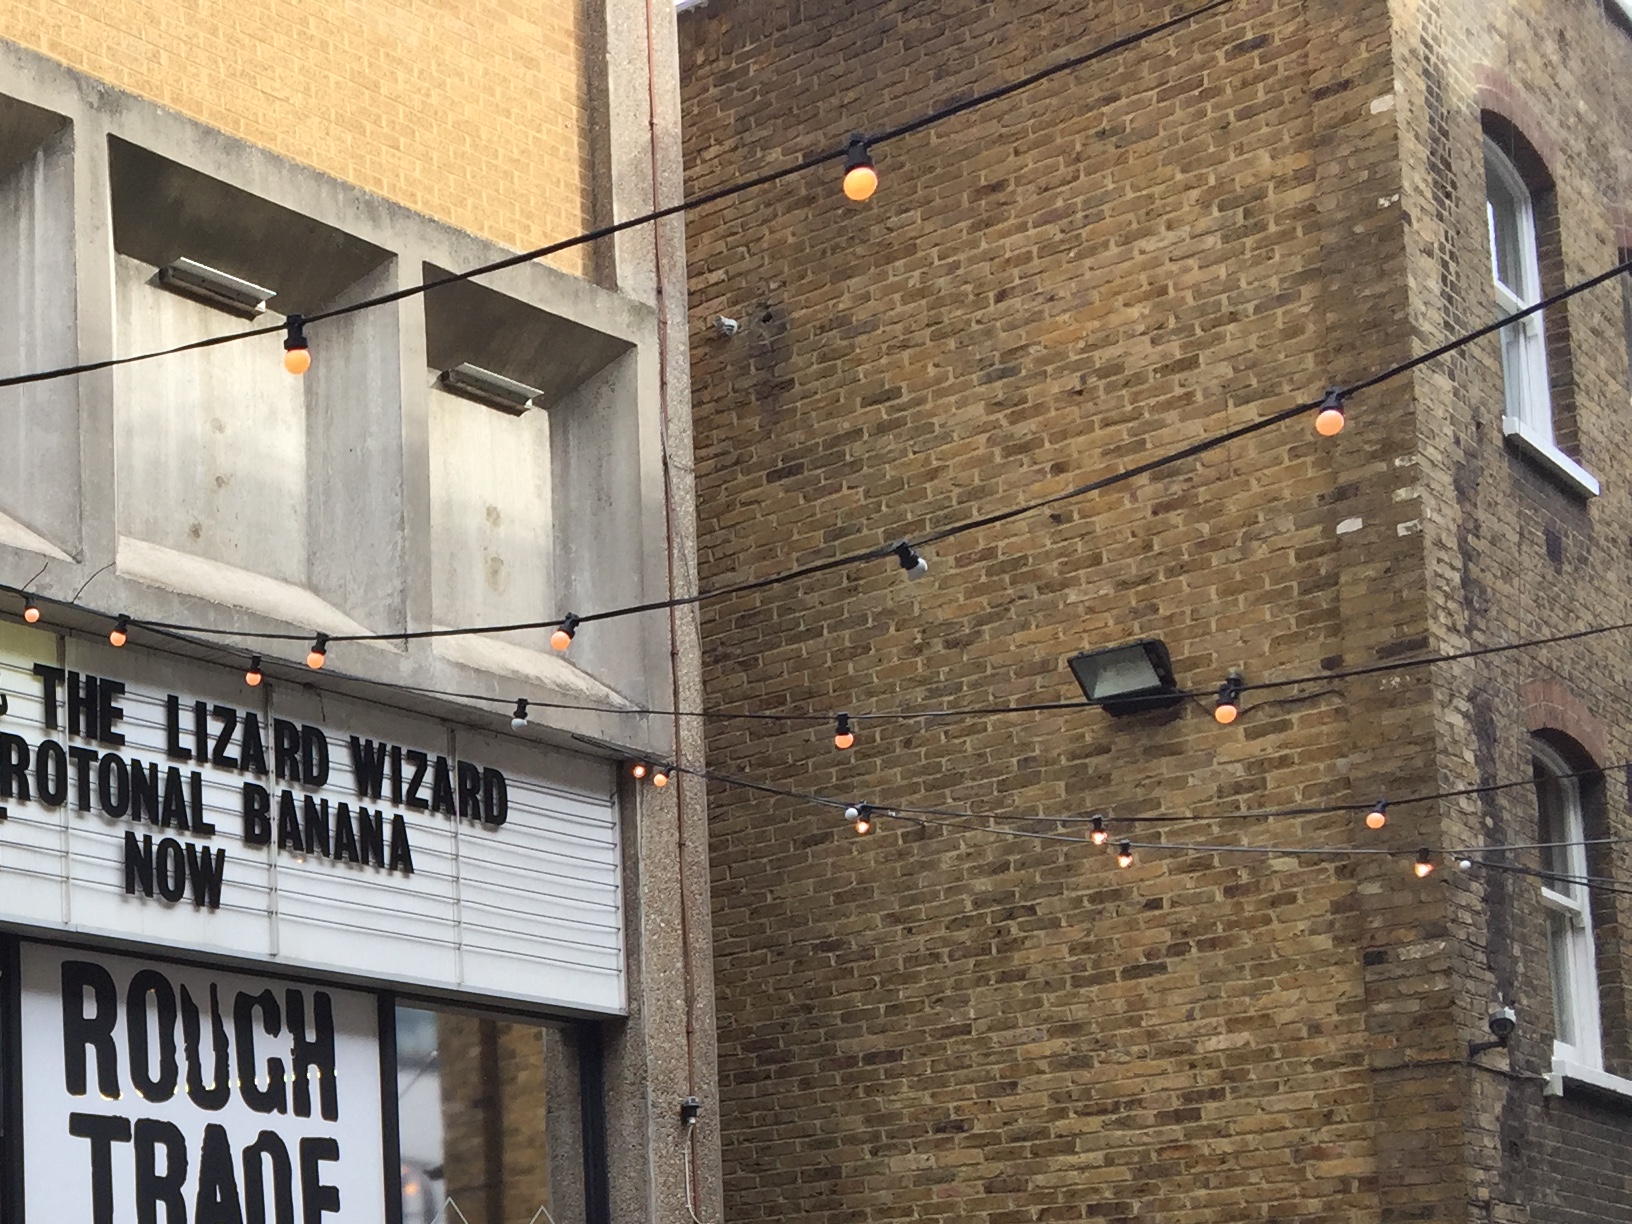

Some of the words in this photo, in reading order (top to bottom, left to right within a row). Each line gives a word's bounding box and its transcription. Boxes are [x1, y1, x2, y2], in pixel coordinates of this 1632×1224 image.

[33, 662, 126, 746] THE
[167, 694, 330, 788] LIZARD
[350, 735, 509, 826] WIZARD
[123, 830, 226, 910] NOW
[243, 782, 415, 874] BANANA
[60, 960, 339, 1123] ROUGH
